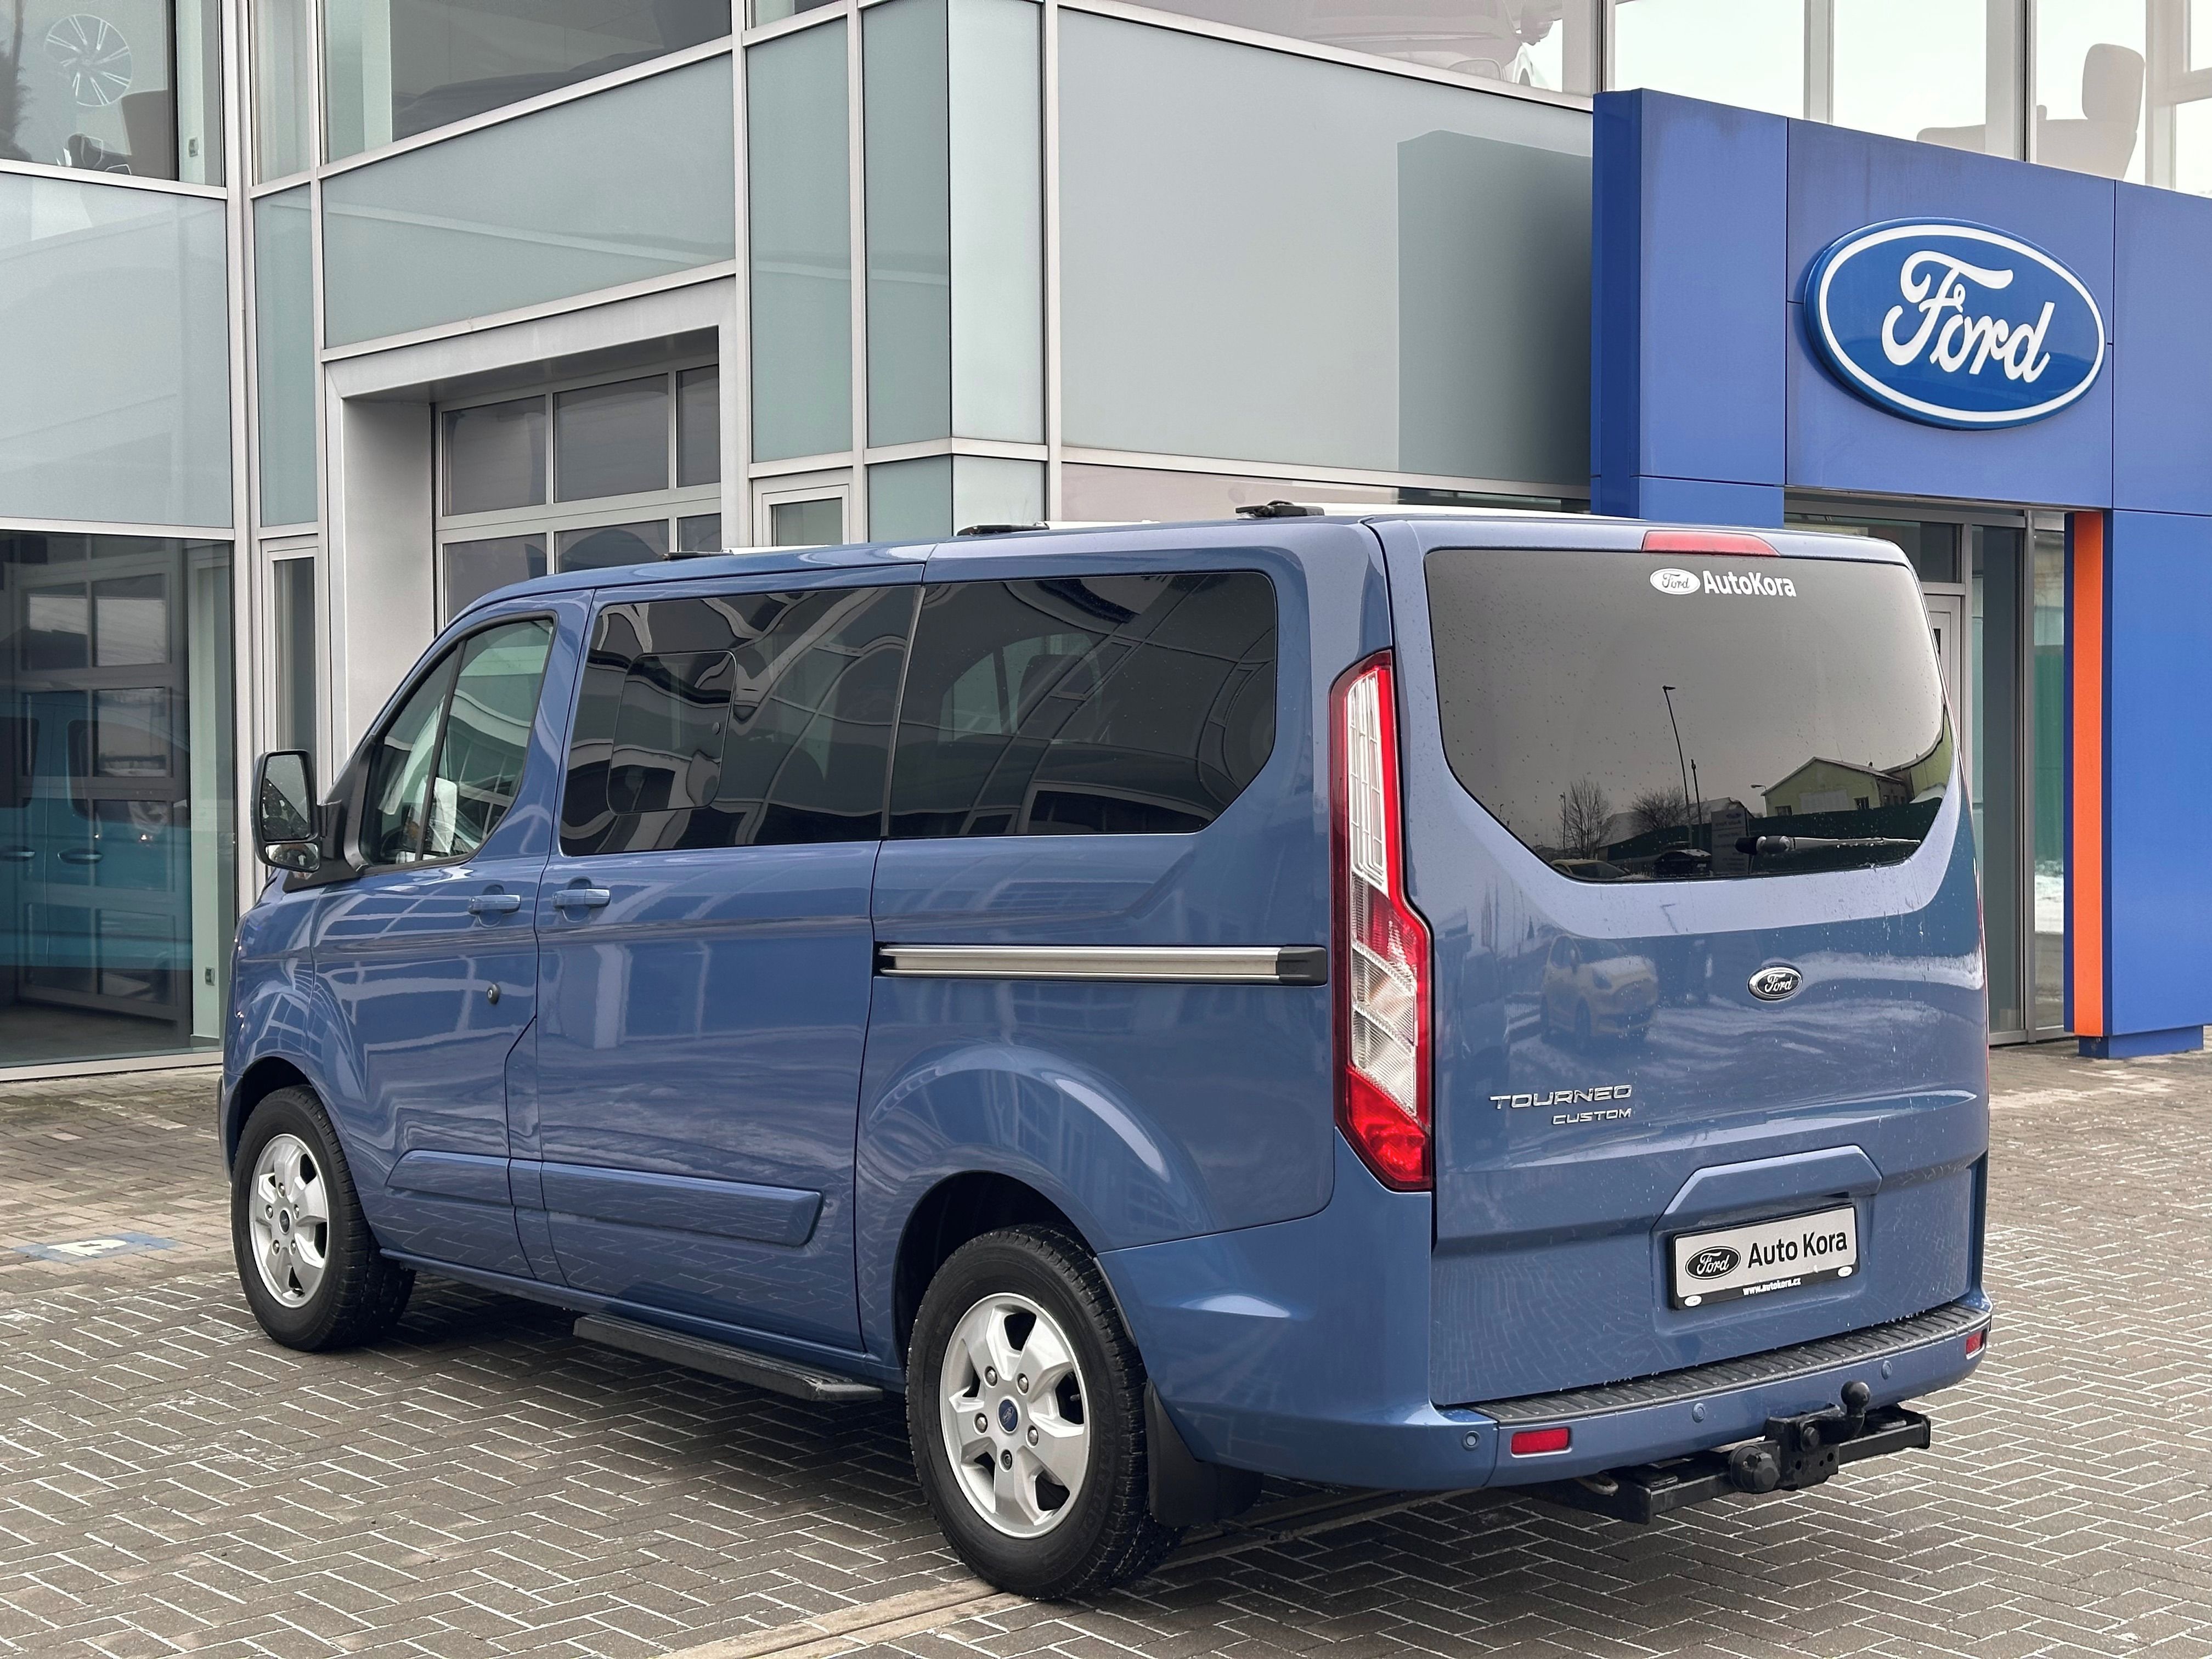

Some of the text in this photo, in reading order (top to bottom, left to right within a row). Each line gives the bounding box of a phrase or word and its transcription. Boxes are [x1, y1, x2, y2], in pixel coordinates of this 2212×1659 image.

[1881, 250, 2055, 383] Ford
[1662, 570, 1797, 597] Ford AutoKora
[1764, 973, 1793, 992] Ford
[1489, 1084, 1632, 1110] TOURNEO
[1552, 1108, 1632, 1125] CUSTOM
[1696, 1231, 1848, 1275] Ford Auto Kora
[1742, 1278, 1801, 1296] www.autokora.cz
